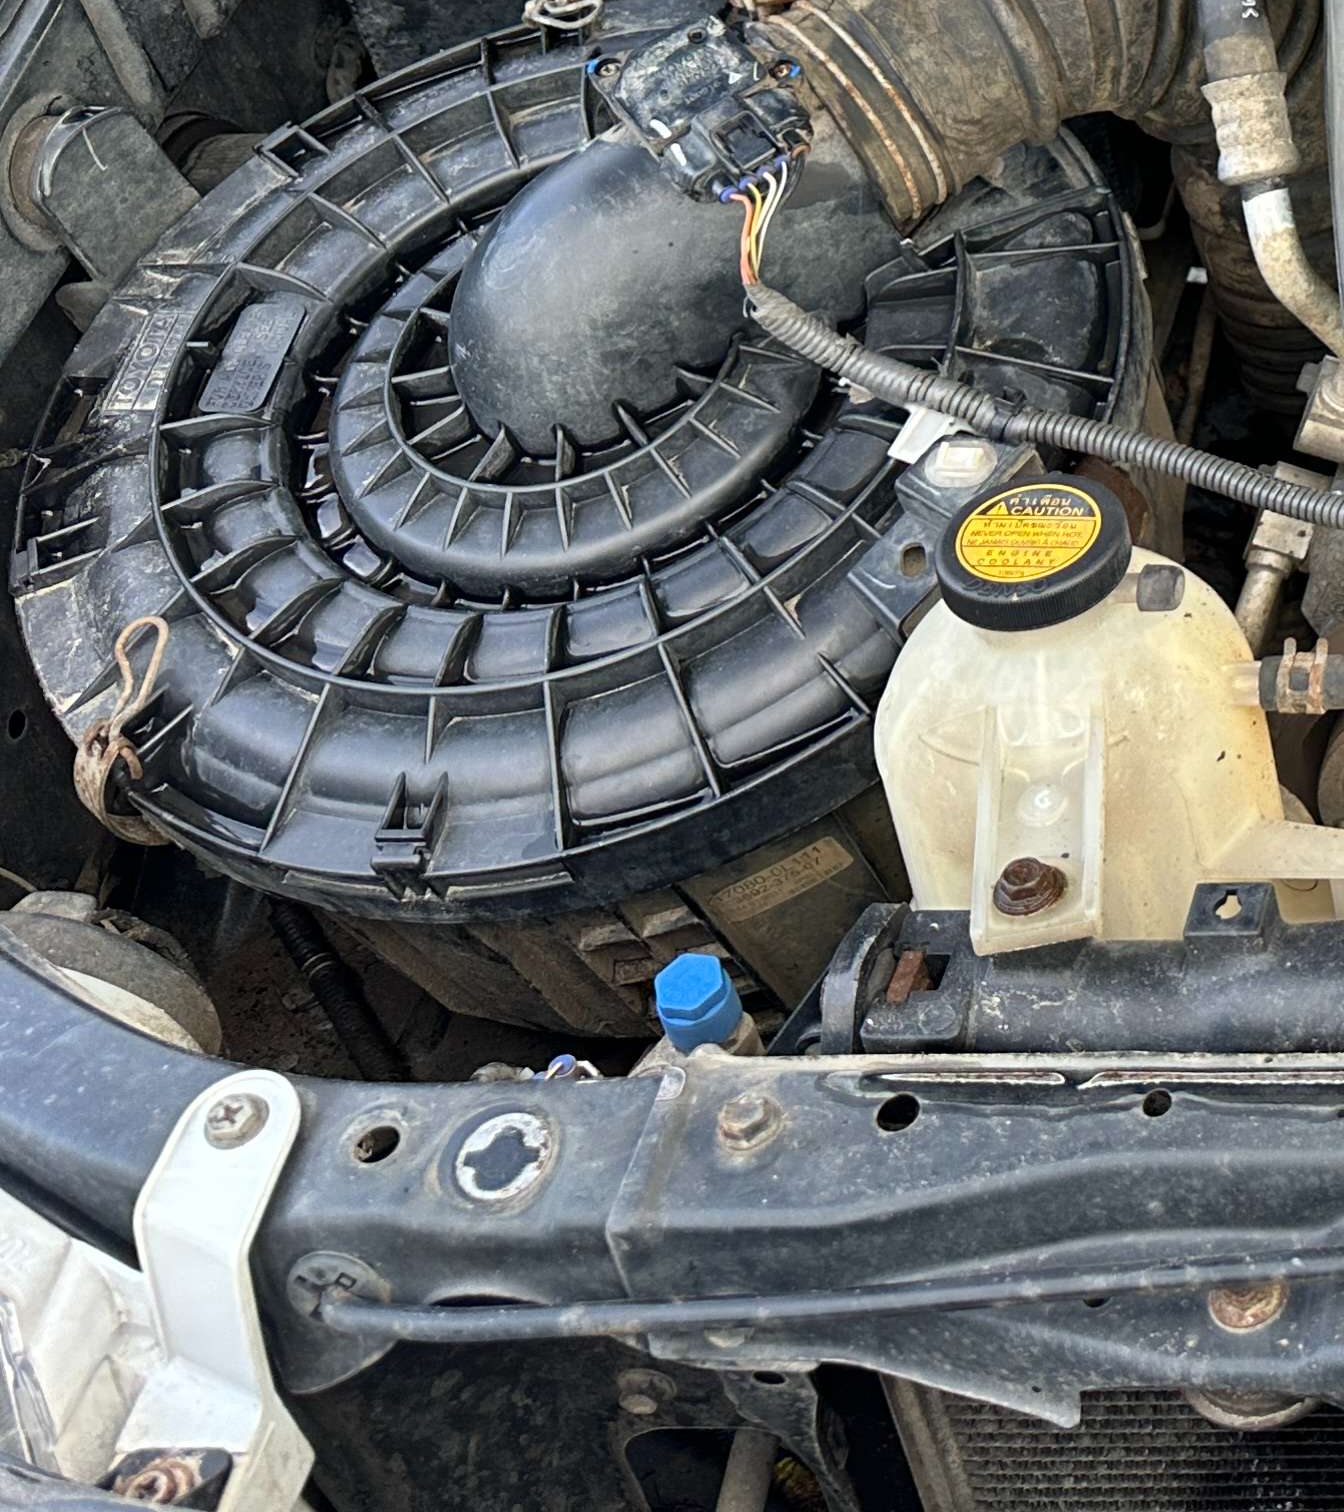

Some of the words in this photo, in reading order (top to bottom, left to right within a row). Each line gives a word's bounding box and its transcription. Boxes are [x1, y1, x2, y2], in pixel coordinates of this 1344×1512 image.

[109, 313, 176, 410] TOYOTA
[1011, 506, 1085, 516] CAUTION
[977, 558, 1056, 566] COOLANT
